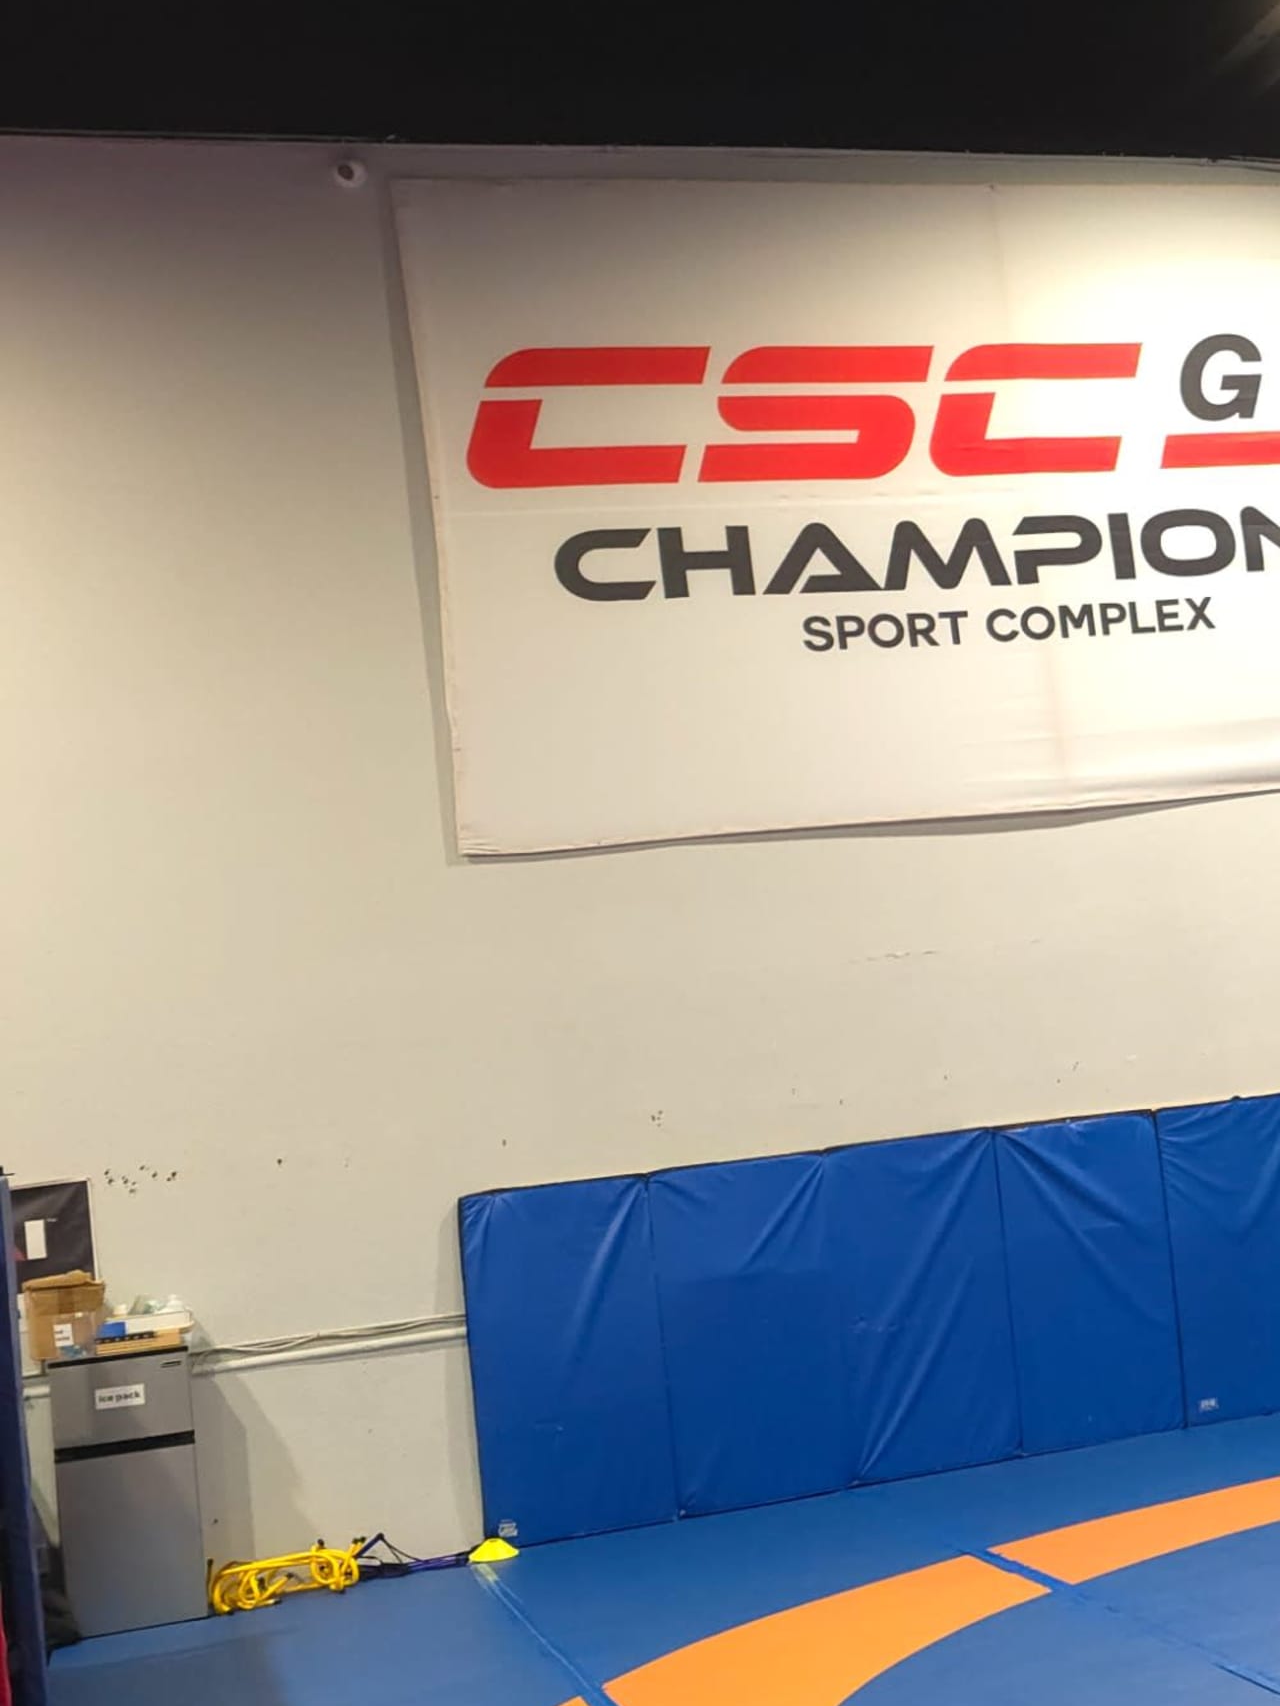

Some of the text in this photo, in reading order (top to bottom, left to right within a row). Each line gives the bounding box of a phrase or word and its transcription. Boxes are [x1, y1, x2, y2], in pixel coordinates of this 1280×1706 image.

[466, 342, 1142, 489] CSC
[803, 596, 1216, 652] SPORT COMPLEX
